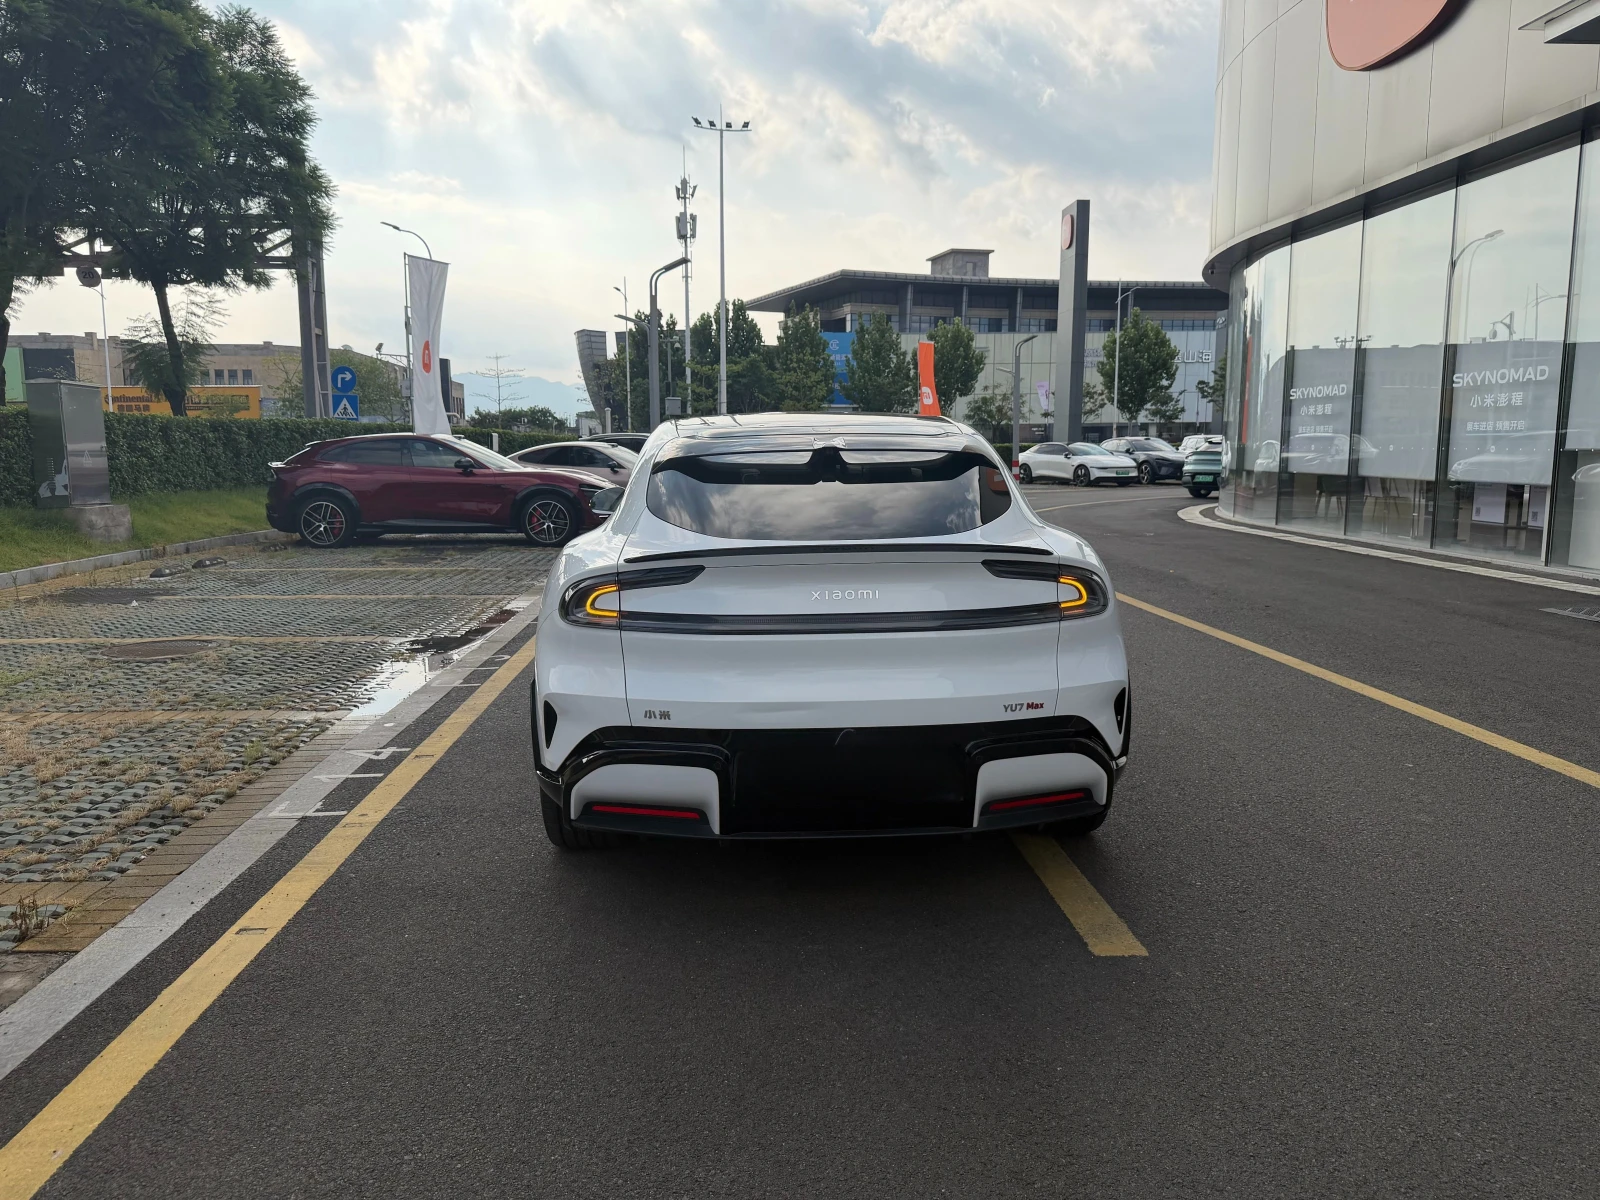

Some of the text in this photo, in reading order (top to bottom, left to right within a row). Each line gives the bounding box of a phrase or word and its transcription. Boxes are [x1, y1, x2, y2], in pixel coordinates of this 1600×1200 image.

[81, 270, 95, 279] 20
[1452, 365, 1549, 387] SKYNOMAD
[1289, 383, 1347, 400] SKYNOMAD
[1470, 392, 1523, 408] 小米澎程
[1300, 403, 1333, 416] 小米澎程
[1466, 420, 1525, 432] 展车进店 预售开启
[810, 589, 880, 601] xiaomi
[1003, 701, 1045, 713] YU7 Max
[643, 709, 672, 721] 小米
